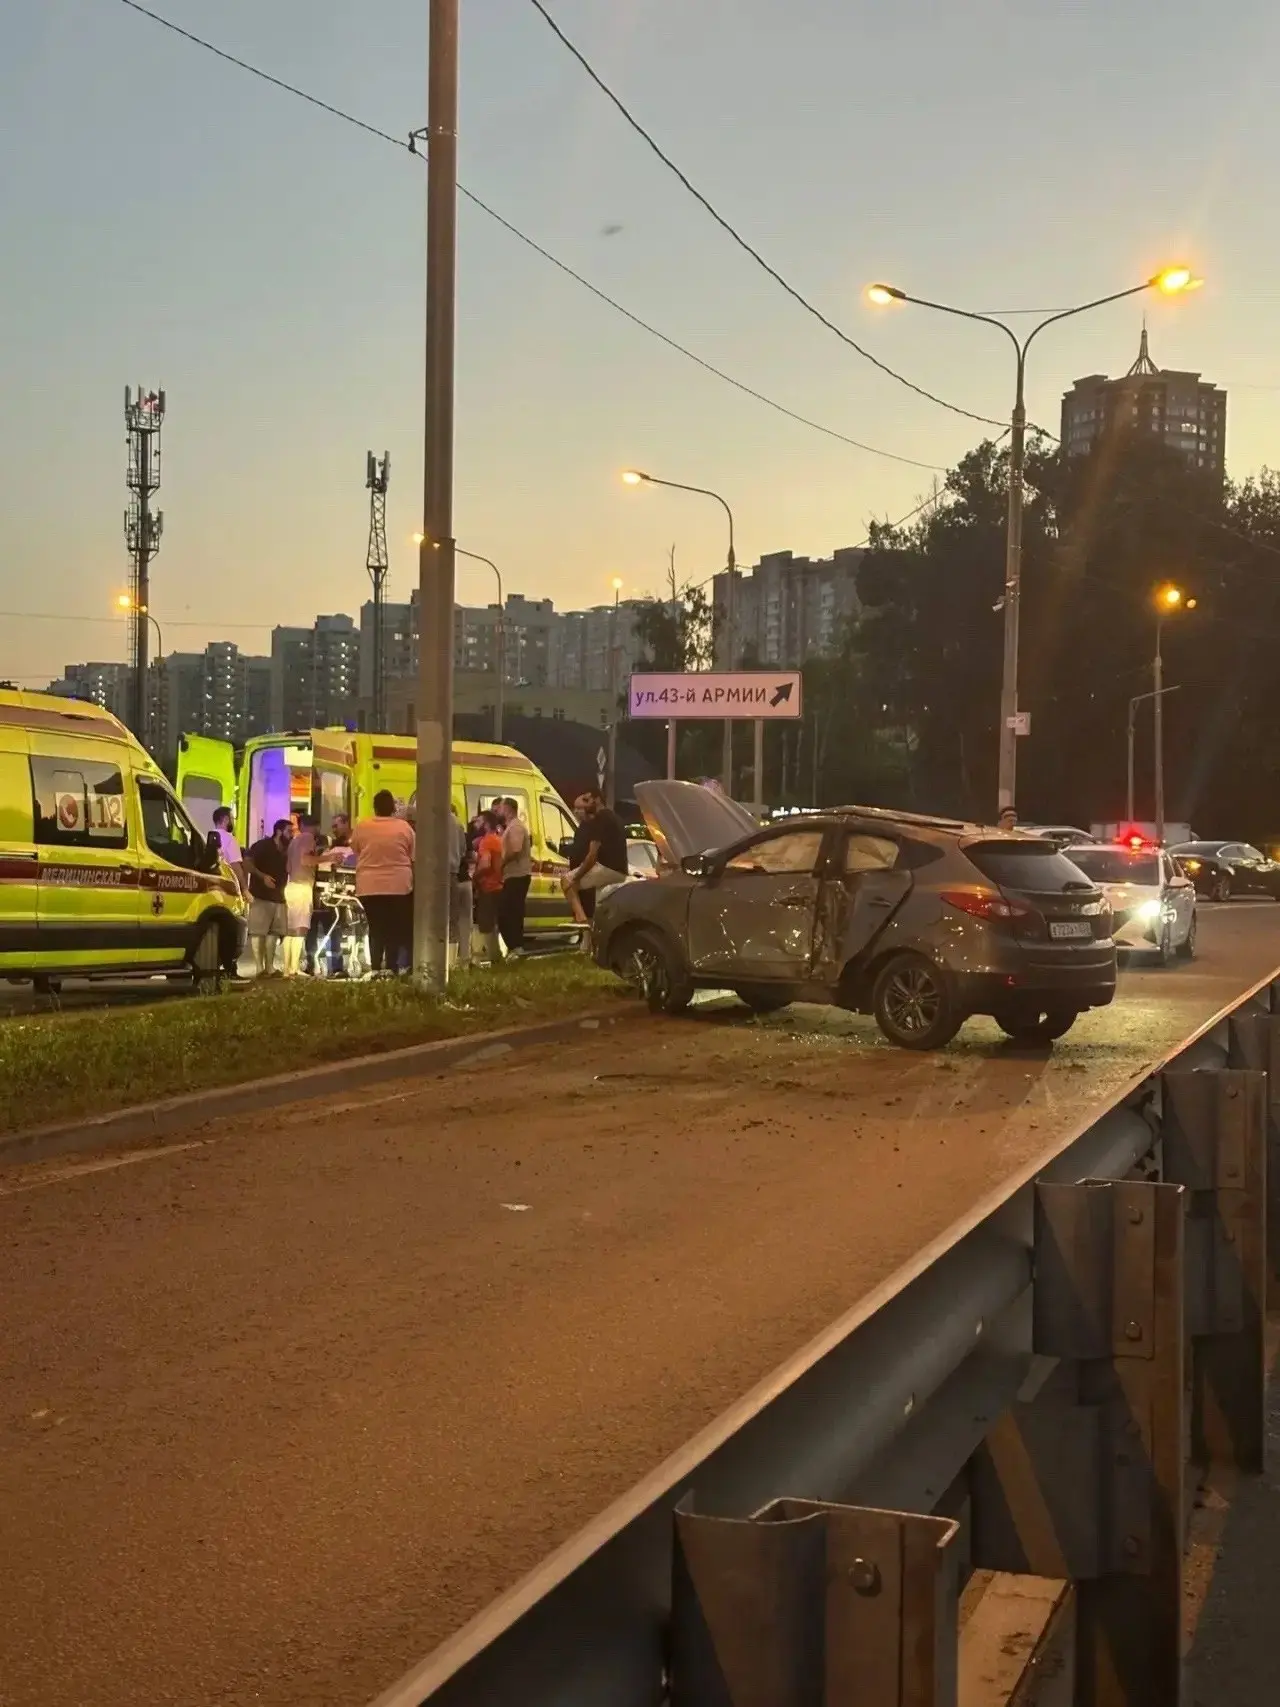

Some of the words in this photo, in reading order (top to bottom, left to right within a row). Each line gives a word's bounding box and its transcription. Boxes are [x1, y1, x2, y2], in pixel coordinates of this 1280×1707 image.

[635, 687, 696, 707] ул.43-й
[702, 687, 767, 703] АРМИИ
[41, 867, 122, 885] МЕДИЦИНСКАЯ
[158, 874, 198, 891] ПОМОЩЬ
